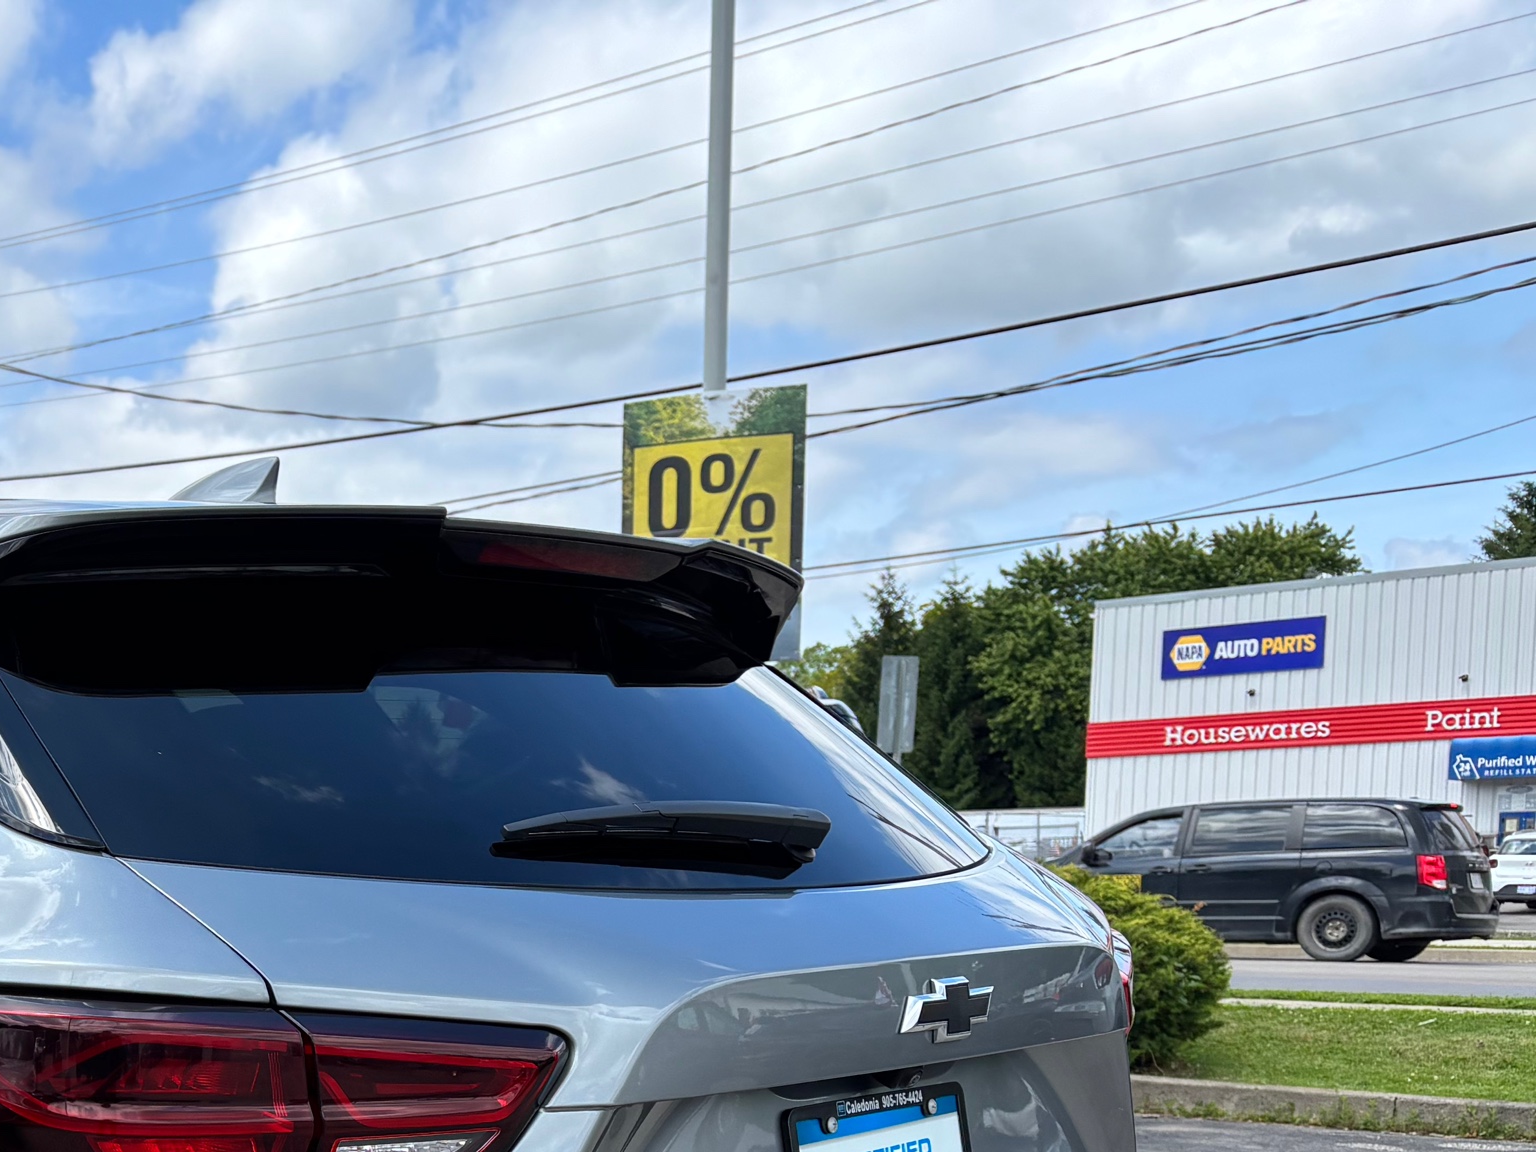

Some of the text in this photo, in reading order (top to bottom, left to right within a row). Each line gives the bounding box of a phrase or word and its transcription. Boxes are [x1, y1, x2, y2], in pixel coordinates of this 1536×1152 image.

[647, 448, 776, 538] 0%
[1176, 633, 1317, 661] NAPA AUTO PARTS
[1163, 707, 1502, 747] Housewares Paint
[1477, 755, 1523, 769] Purified
[1484, 769, 1513, 777] REFILL
[845, 1097, 880, 1115] Caledonia
[881, 1089, 923, 1109] 905-765-4424
